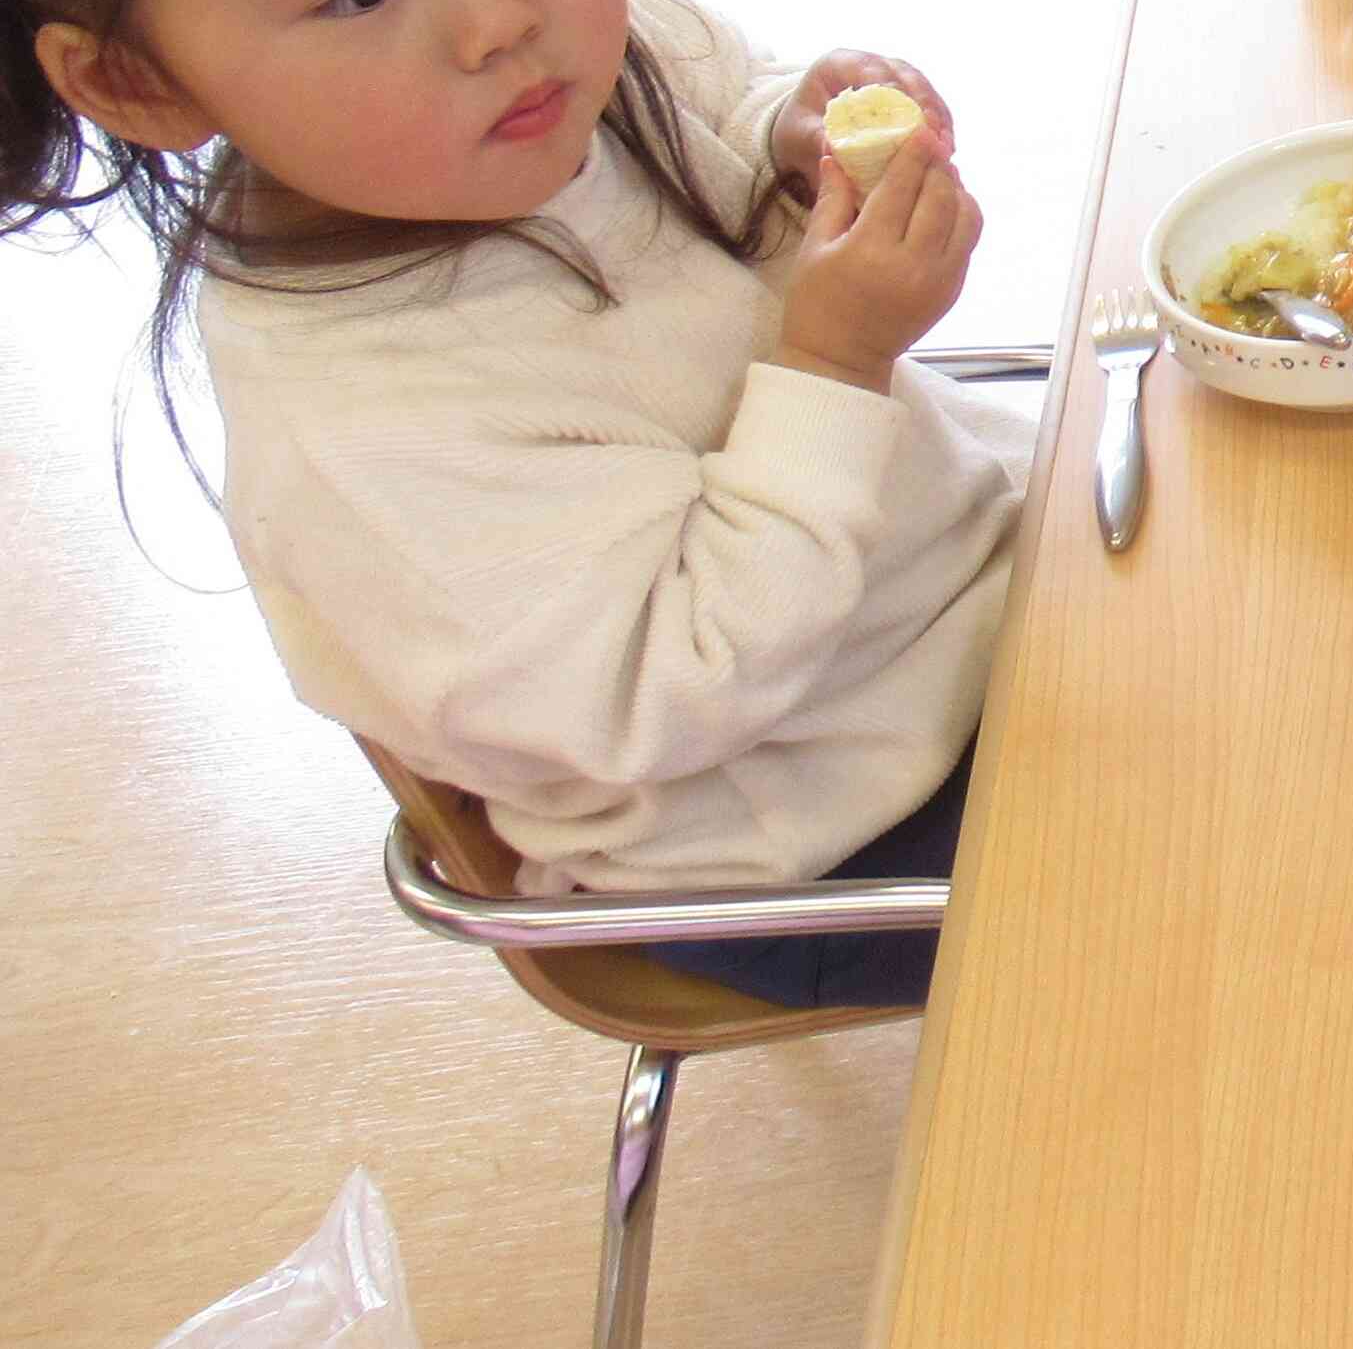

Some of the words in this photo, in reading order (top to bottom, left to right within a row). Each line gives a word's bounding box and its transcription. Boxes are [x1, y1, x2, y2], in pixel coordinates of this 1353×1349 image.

[1249, 358, 1260, 370] C
[1280, 357, 1294, 370] D
[1319, 355, 1332, 369] E
